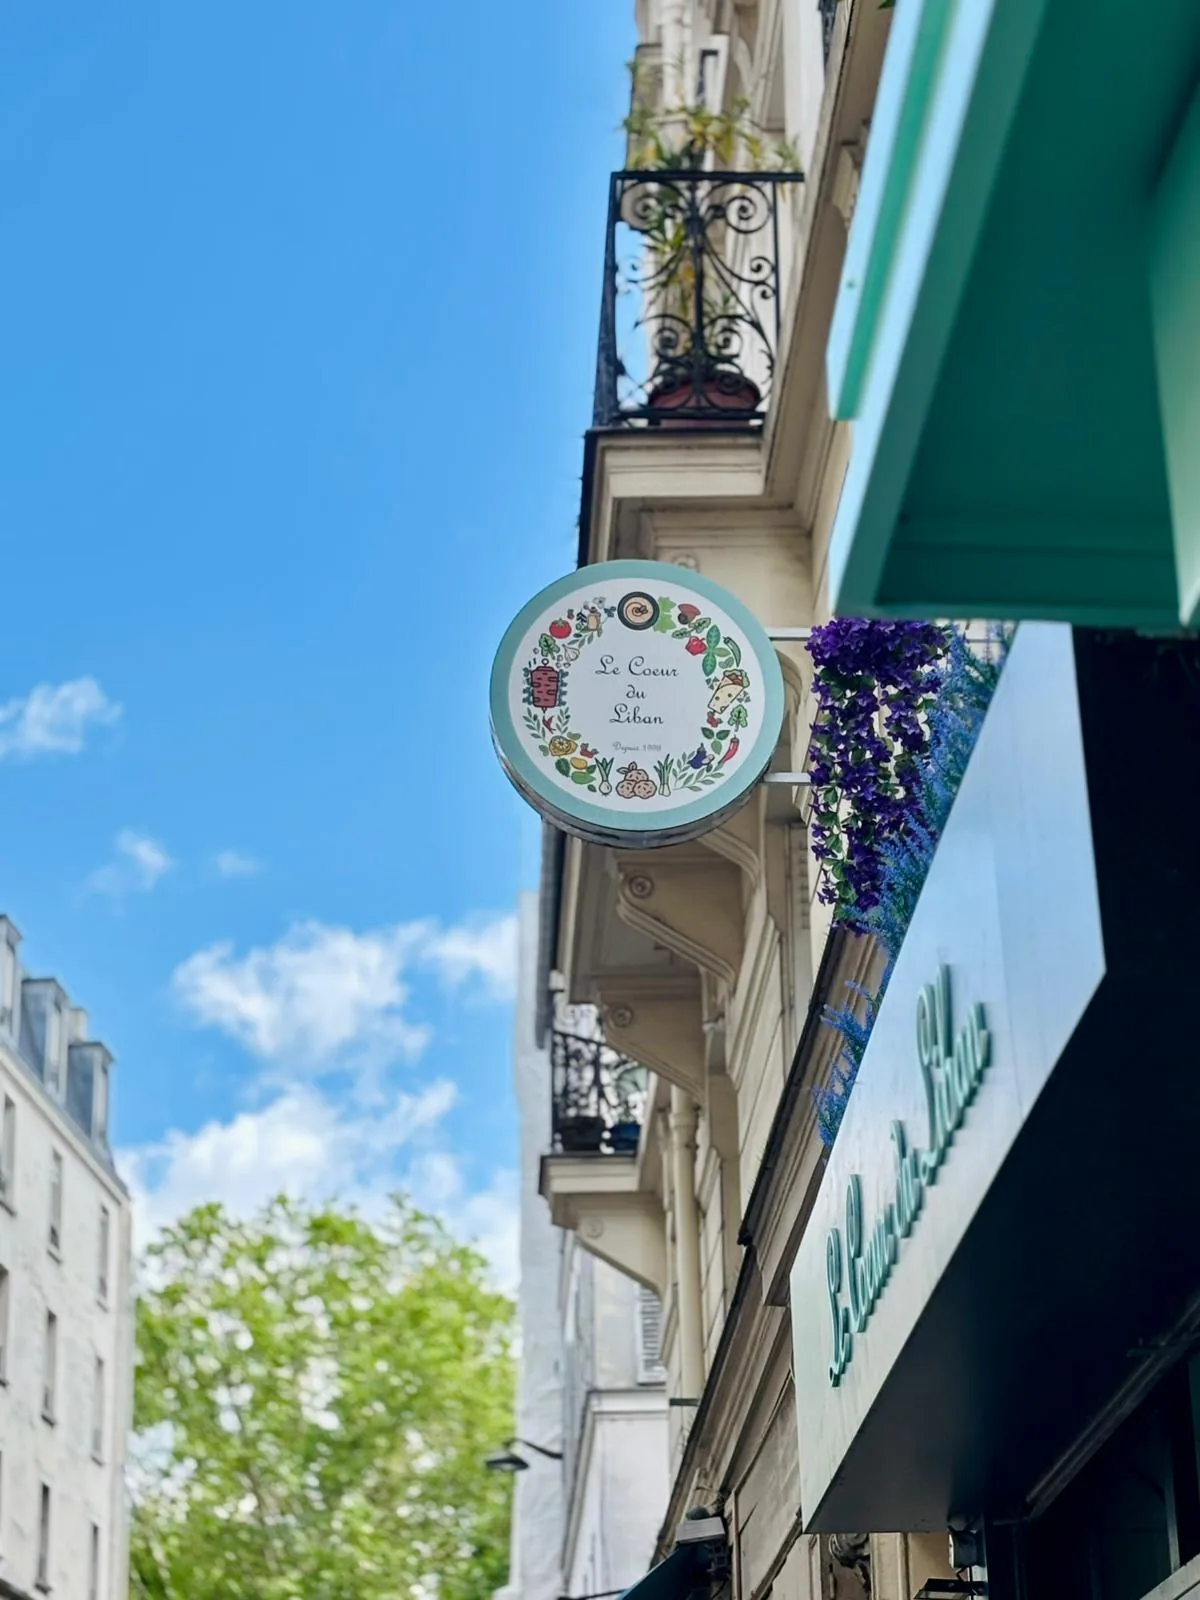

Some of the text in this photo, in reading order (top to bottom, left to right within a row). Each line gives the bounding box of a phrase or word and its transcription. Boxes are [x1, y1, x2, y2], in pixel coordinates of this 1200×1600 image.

[595, 655, 678, 676] Le Coeur
[626, 684, 646, 699] du
[610, 703, 664, 724] Liban
